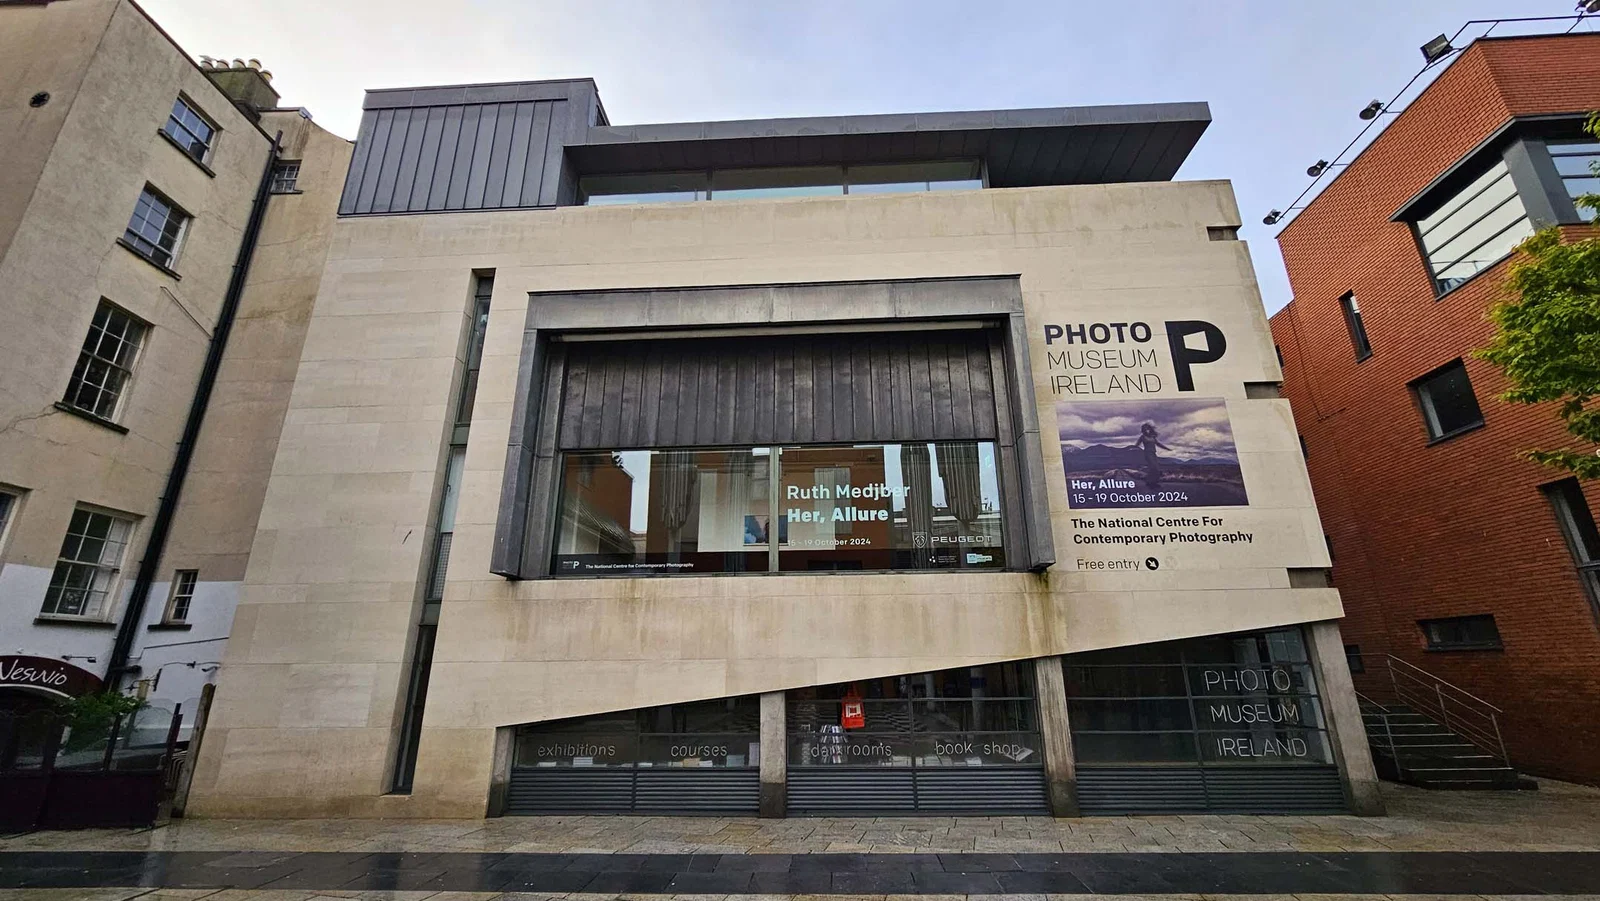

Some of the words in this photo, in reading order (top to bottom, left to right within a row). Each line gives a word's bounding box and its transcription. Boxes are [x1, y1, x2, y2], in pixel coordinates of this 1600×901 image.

[1044, 321, 1153, 345] PHOTO
[1047, 348, 1158, 370] MUSEUM
[1164, 320, 1227, 392] P
[1051, 373, 1162, 395] IRELAND
[787, 485, 830, 500] Ruth
[836, 483, 911, 501] Medjber
[1071, 479, 1097, 491] Her,
[1098, 478, 1136, 489] Allure
[1073, 493, 1086, 504] 15
[1095, 493, 1107, 503] 19
[1110, 491, 1156, 503] October
[1158, 491, 1189, 502] 2024
[787, 508, 826, 524] Her,
[830, 506, 889, 522] Allure
[1071, 518, 1095, 529] The
[1098, 517, 1153, 528] National
[1156, 517, 1200, 527] Centre
[1202, 516, 1224, 526] For
[804, 539, 813, 547] 19
[814, 538, 848, 546] October
[849, 538, 871, 546] 2024
[931, 535, 993, 543] PEUGEOT
[1073, 532, 1166, 545] Contemporary
[1169, 531, 1253, 546] Photography
[1077, 558, 1105, 570] Free
[1107, 558, 1140, 572] entry
[0, 659, 68, 685] Vesuvio
[1204, 669, 1291, 691] PHOTO
[1210, 704, 1299, 723] MUSEUM
[537, 743, 616, 757] exhibitions
[671, 744, 728, 757] courses
[811, 743, 893, 758] darkrooms
[935, 741, 973, 755] book
[983, 741, 1021, 756] shop
[1217, 738, 1307, 757] IRELAND
